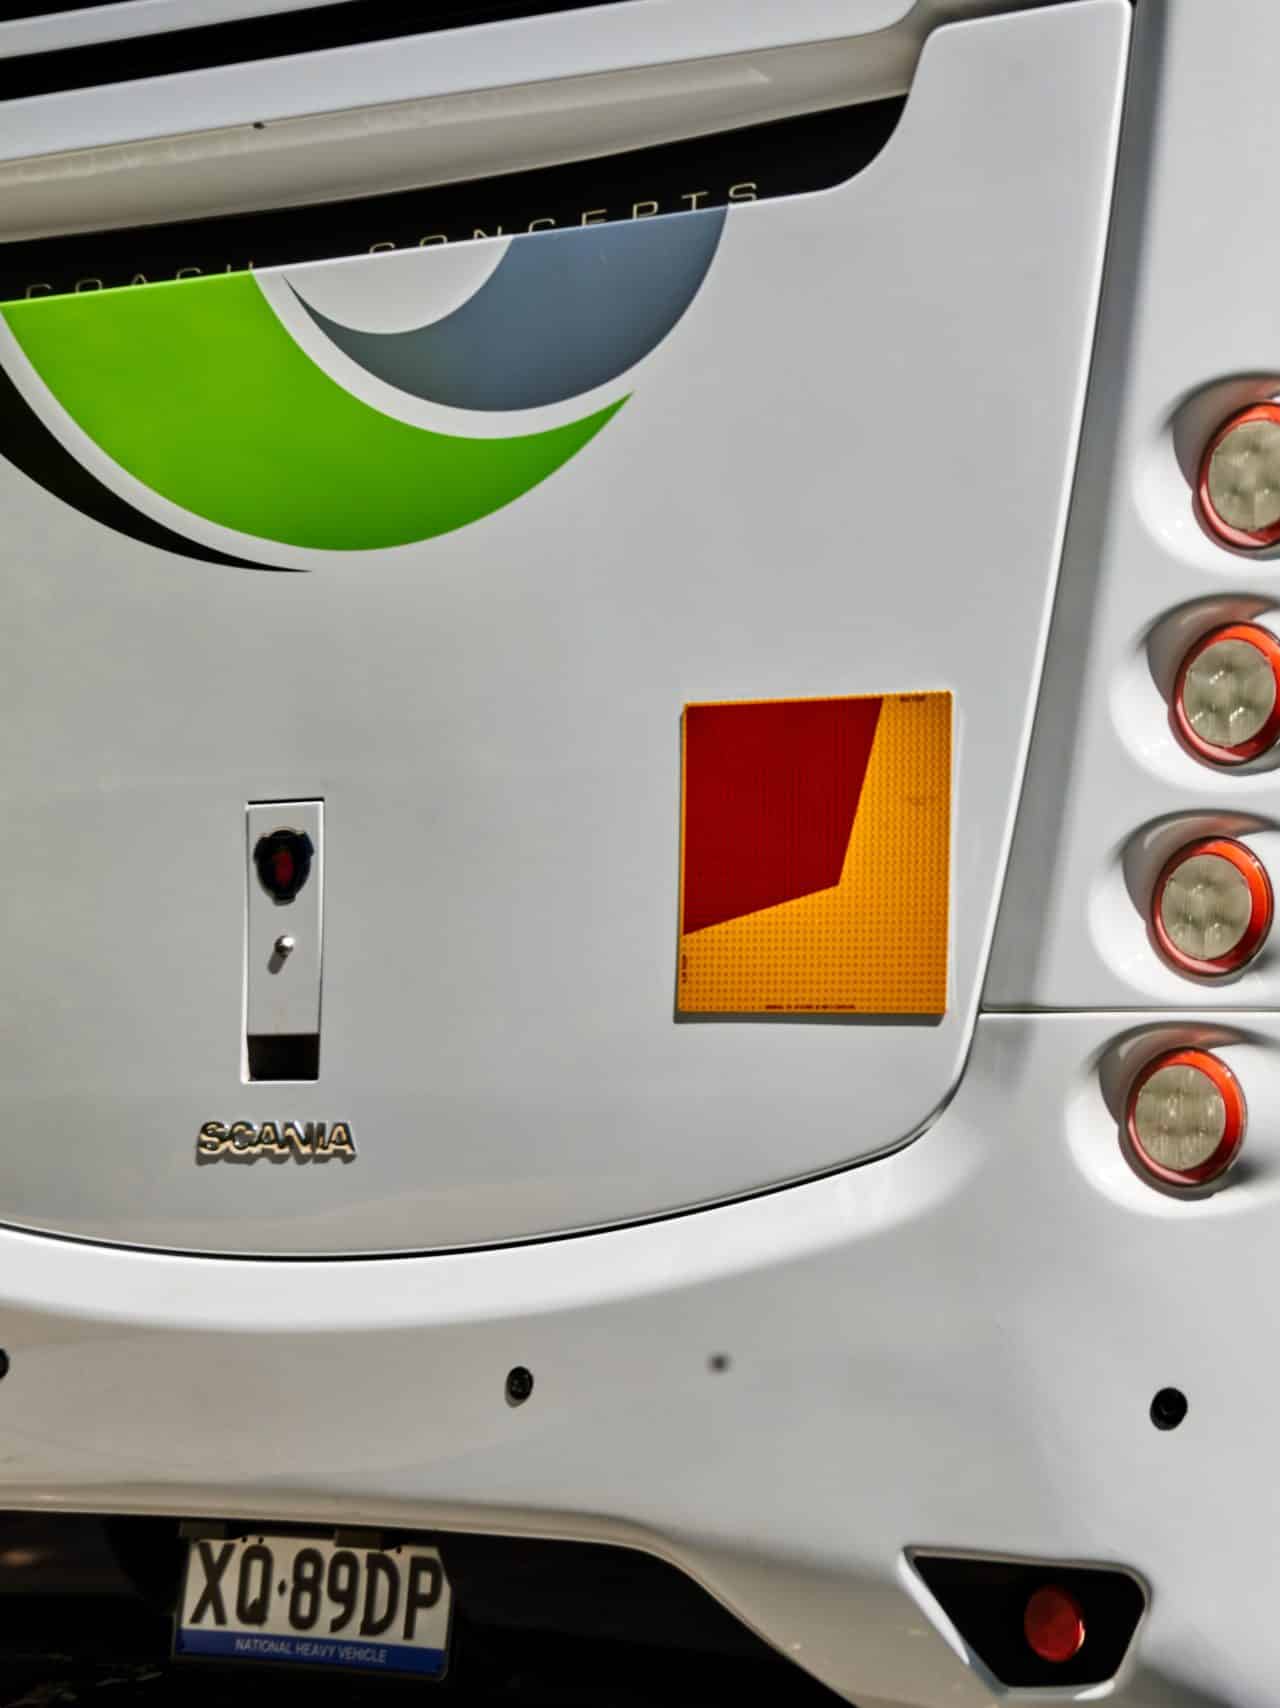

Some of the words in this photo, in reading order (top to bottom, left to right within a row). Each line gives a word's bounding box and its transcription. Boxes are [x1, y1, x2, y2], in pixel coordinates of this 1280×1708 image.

[199, 1120, 356, 1155] SCANIA
[235, 1638, 291, 1656] NATIONAL
[295, 1642, 336, 1658] HEAVY
[337, 1646, 388, 1664] VEHICLE
